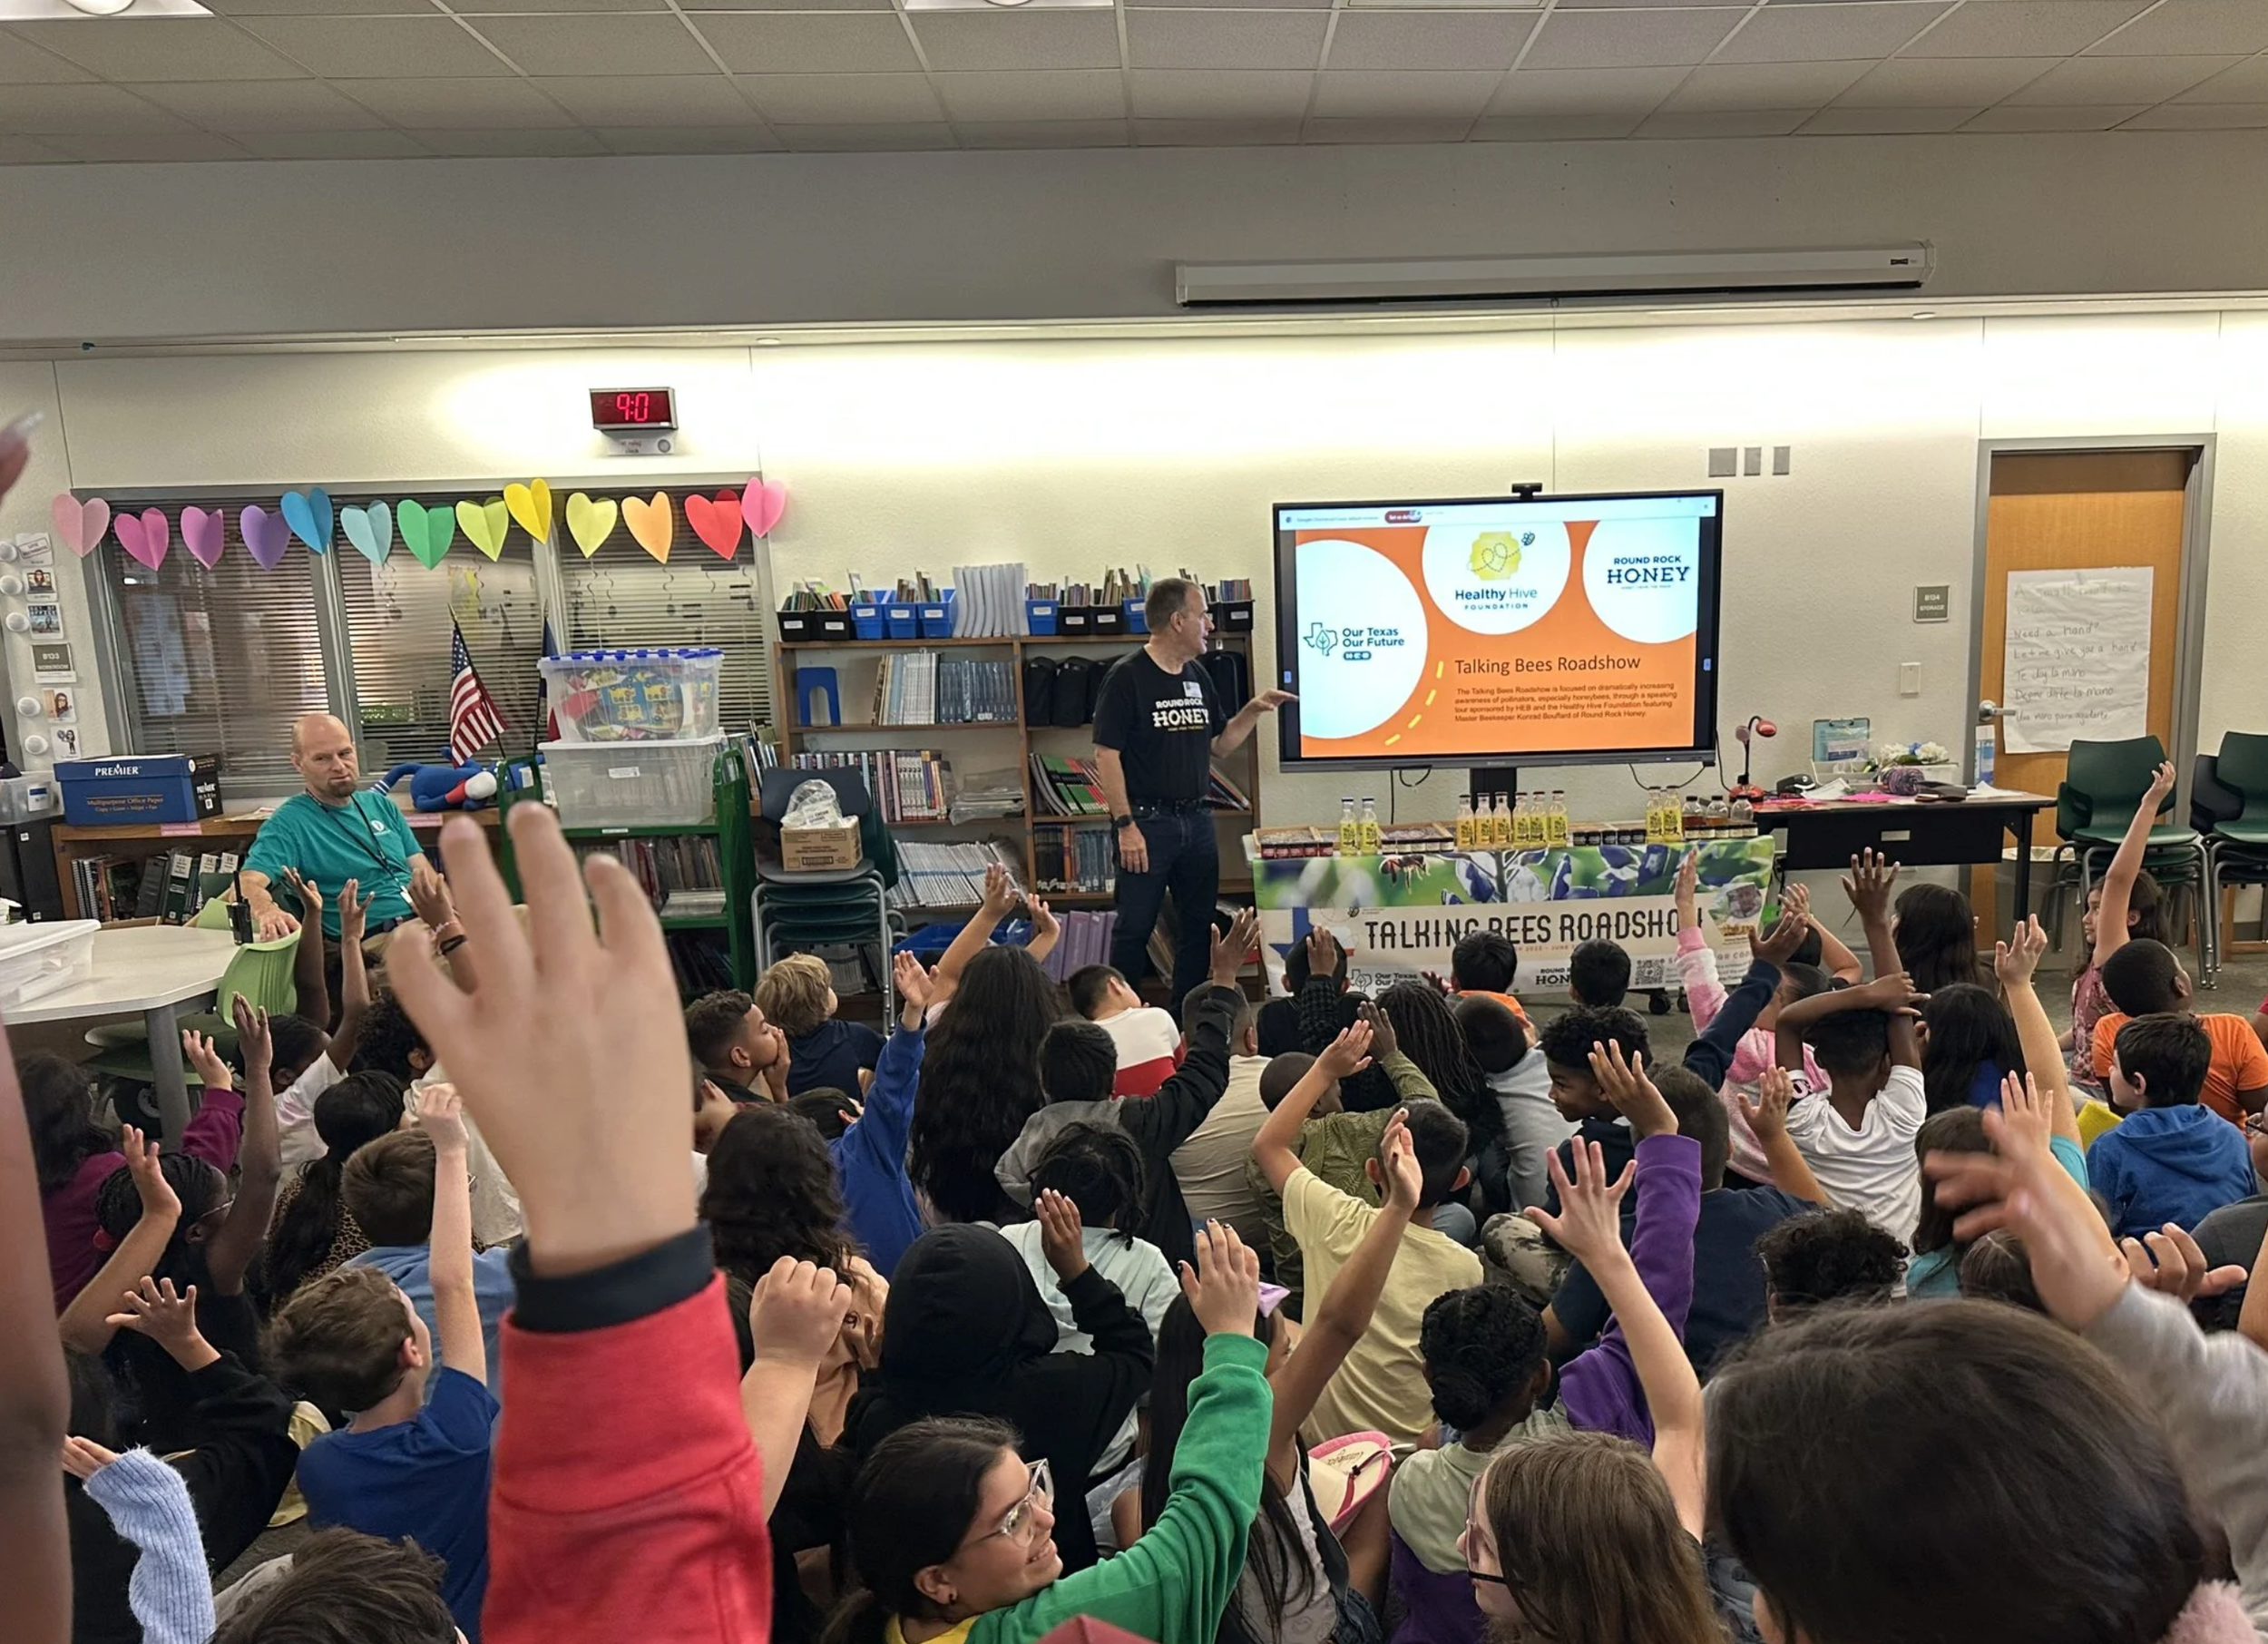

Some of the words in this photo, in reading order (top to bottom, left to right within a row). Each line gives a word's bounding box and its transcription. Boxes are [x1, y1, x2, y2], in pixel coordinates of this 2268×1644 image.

[1614, 556, 1650, 565] ROUND
[1653, 555, 1682, 563] ROCK
[1608, 566, 1690, 584] HONEY
[1455, 589, 1506, 601] Healthy
[1509, 588, 1538, 599] Hive
[1919, 603, 1945, 612] STORAGE
[1343, 628, 1364, 637] Our
[1367, 627, 1399, 637] Texas
[2014, 627, 2039, 639] Need
[1343, 638, 1364, 647] Our
[1367, 637, 1405, 647] Future
[2014, 649, 2035, 660] Let
[2054, 647, 2077, 660] give
[1454, 657, 1510, 676] Talking
[1516, 656, 1553, 673] Bees
[1558, 654, 1642, 672] Roadshow
[1156, 699, 1184, 709] ROUND
[1151, 709, 1209, 728] HONEY
[94, 765, 139, 777] PREMIER
[1559, 907, 1702, 943] ROADSHO
[1535, 974, 1570, 985] HON
